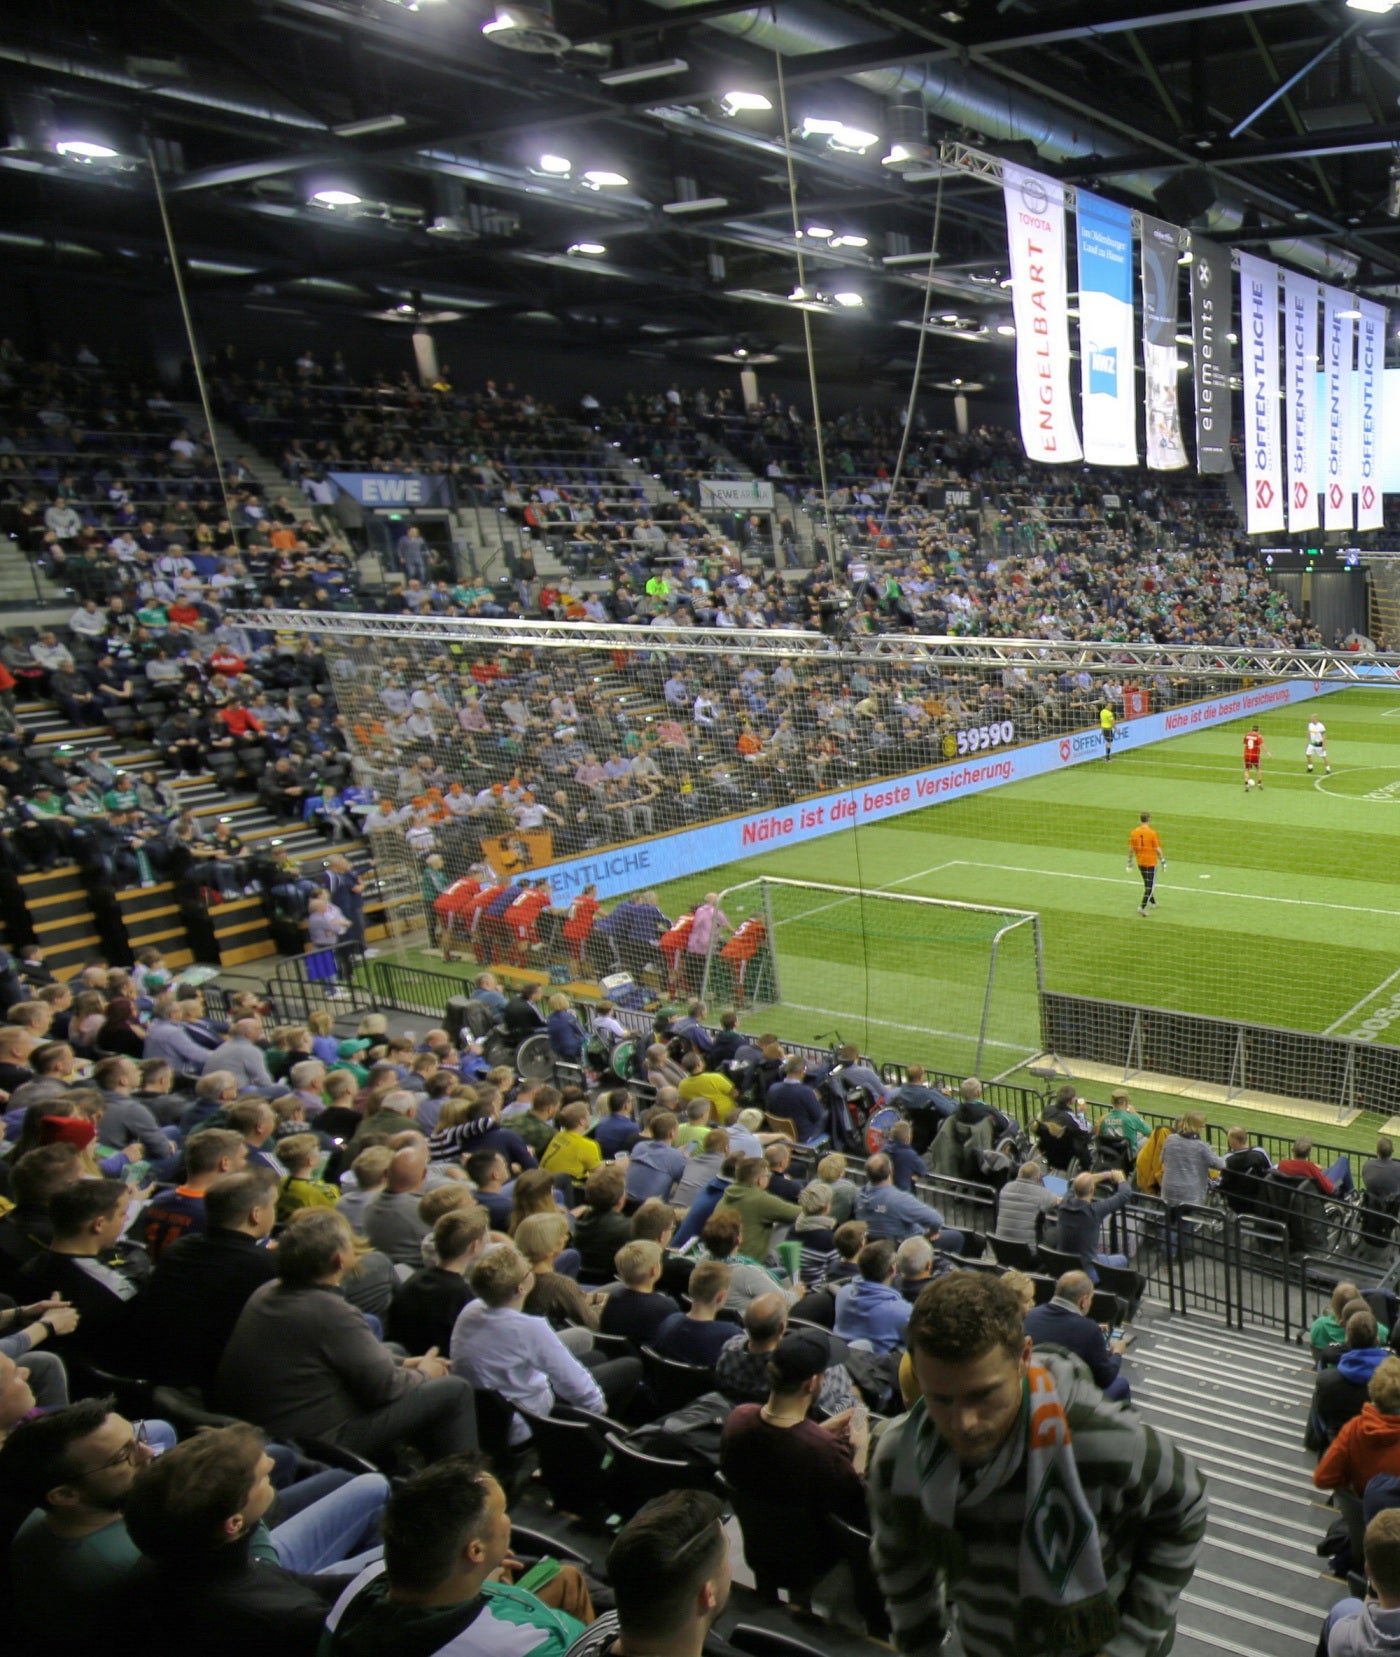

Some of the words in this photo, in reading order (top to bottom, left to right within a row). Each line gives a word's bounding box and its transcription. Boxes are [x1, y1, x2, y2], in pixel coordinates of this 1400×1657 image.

[1018, 212, 1052, 233] TOYOTA
[1083, 241, 1098, 255] Land
[1028, 238, 1057, 451] ENGELBART
[1092, 354, 1115, 375] NWZ
[1200, 299, 1213, 430] elements
[1252, 281, 1268, 470] ÖFFENTLICHE
[1294, 296, 1305, 473] ÖFFENTLICHE
[1361, 321, 1375, 478] ÖFFENTLICHE
[361, 479, 421, 501] EWE
[717, 490, 739, 499] EWE
[945, 491, 970, 505] EWE
[1165, 712, 1188, 731] Nähe
[1190, 709, 1202, 723] ist
[1203, 704, 1216, 720] die
[1219, 700, 1241, 716] beste
[956, 720, 1014, 755] 59590
[742, 817, 794, 846] Nähe
[800, 805, 824, 829] ist
[830, 797, 857, 821] die
[863, 786, 911, 812] beste
[915, 760, 1015, 798] Versicherung.
